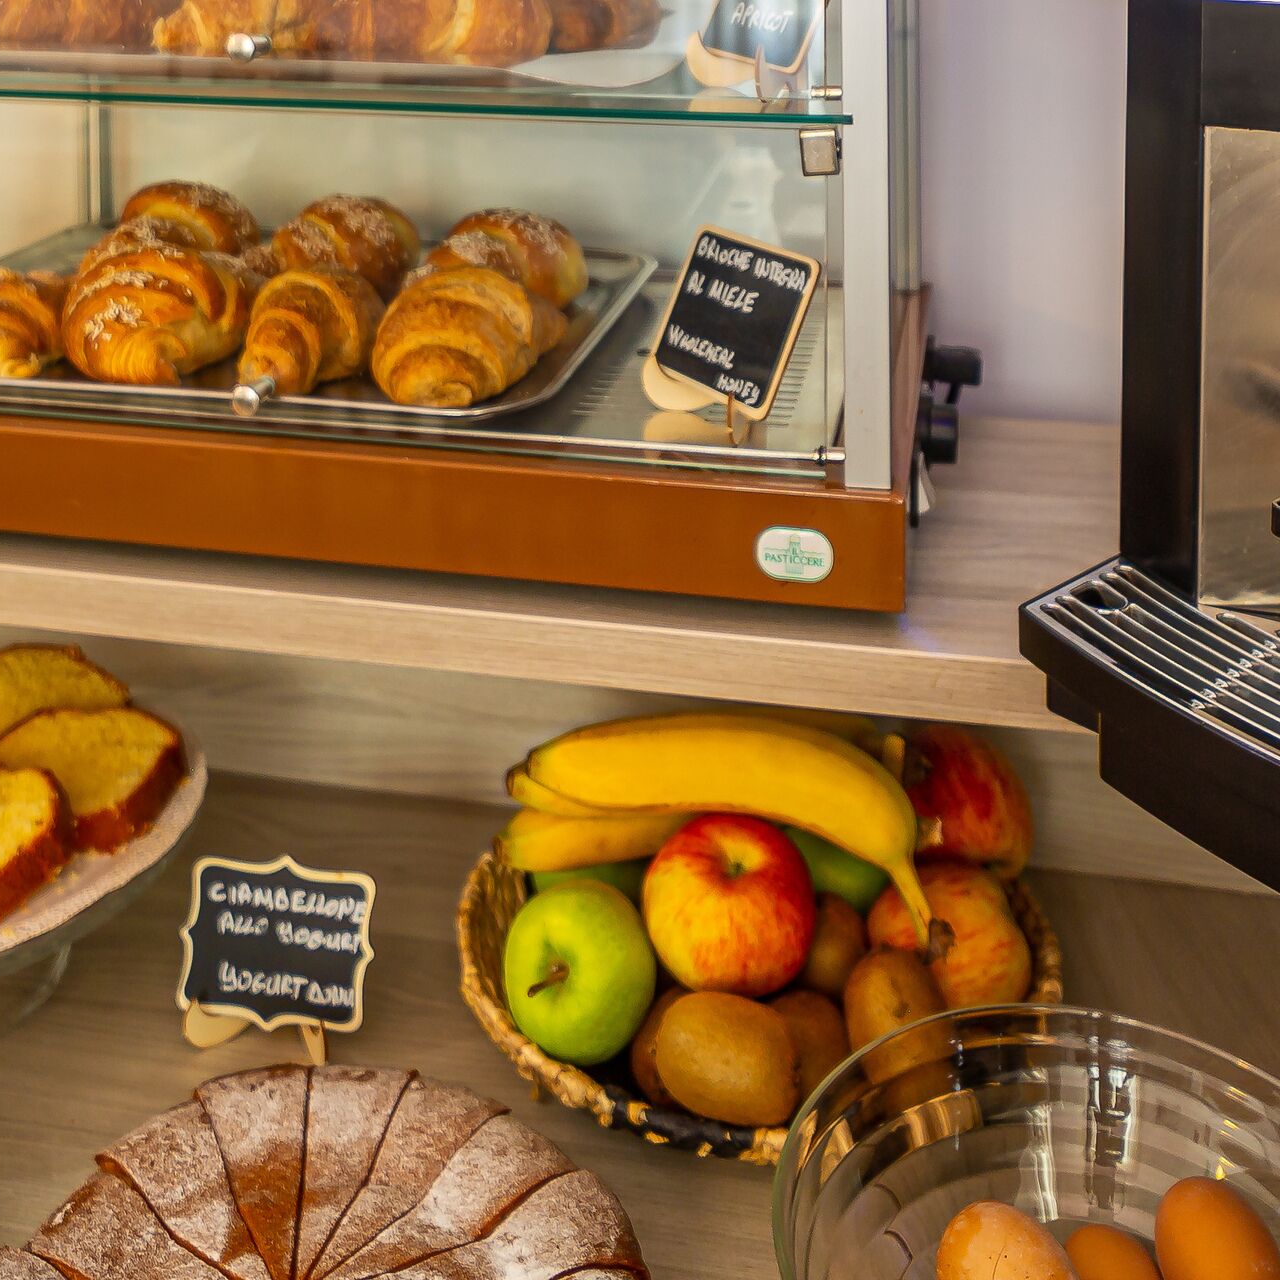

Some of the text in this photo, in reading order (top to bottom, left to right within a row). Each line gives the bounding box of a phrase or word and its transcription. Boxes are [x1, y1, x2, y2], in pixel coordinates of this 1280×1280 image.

[731, 2, 794, 33] APRICOT
[686, 270, 706, 296] AL
[708, 279, 760, 314] MIELE
[764, 552, 825, 567] PASTICCERE
[217, 960, 309, 1001] YOGURT
